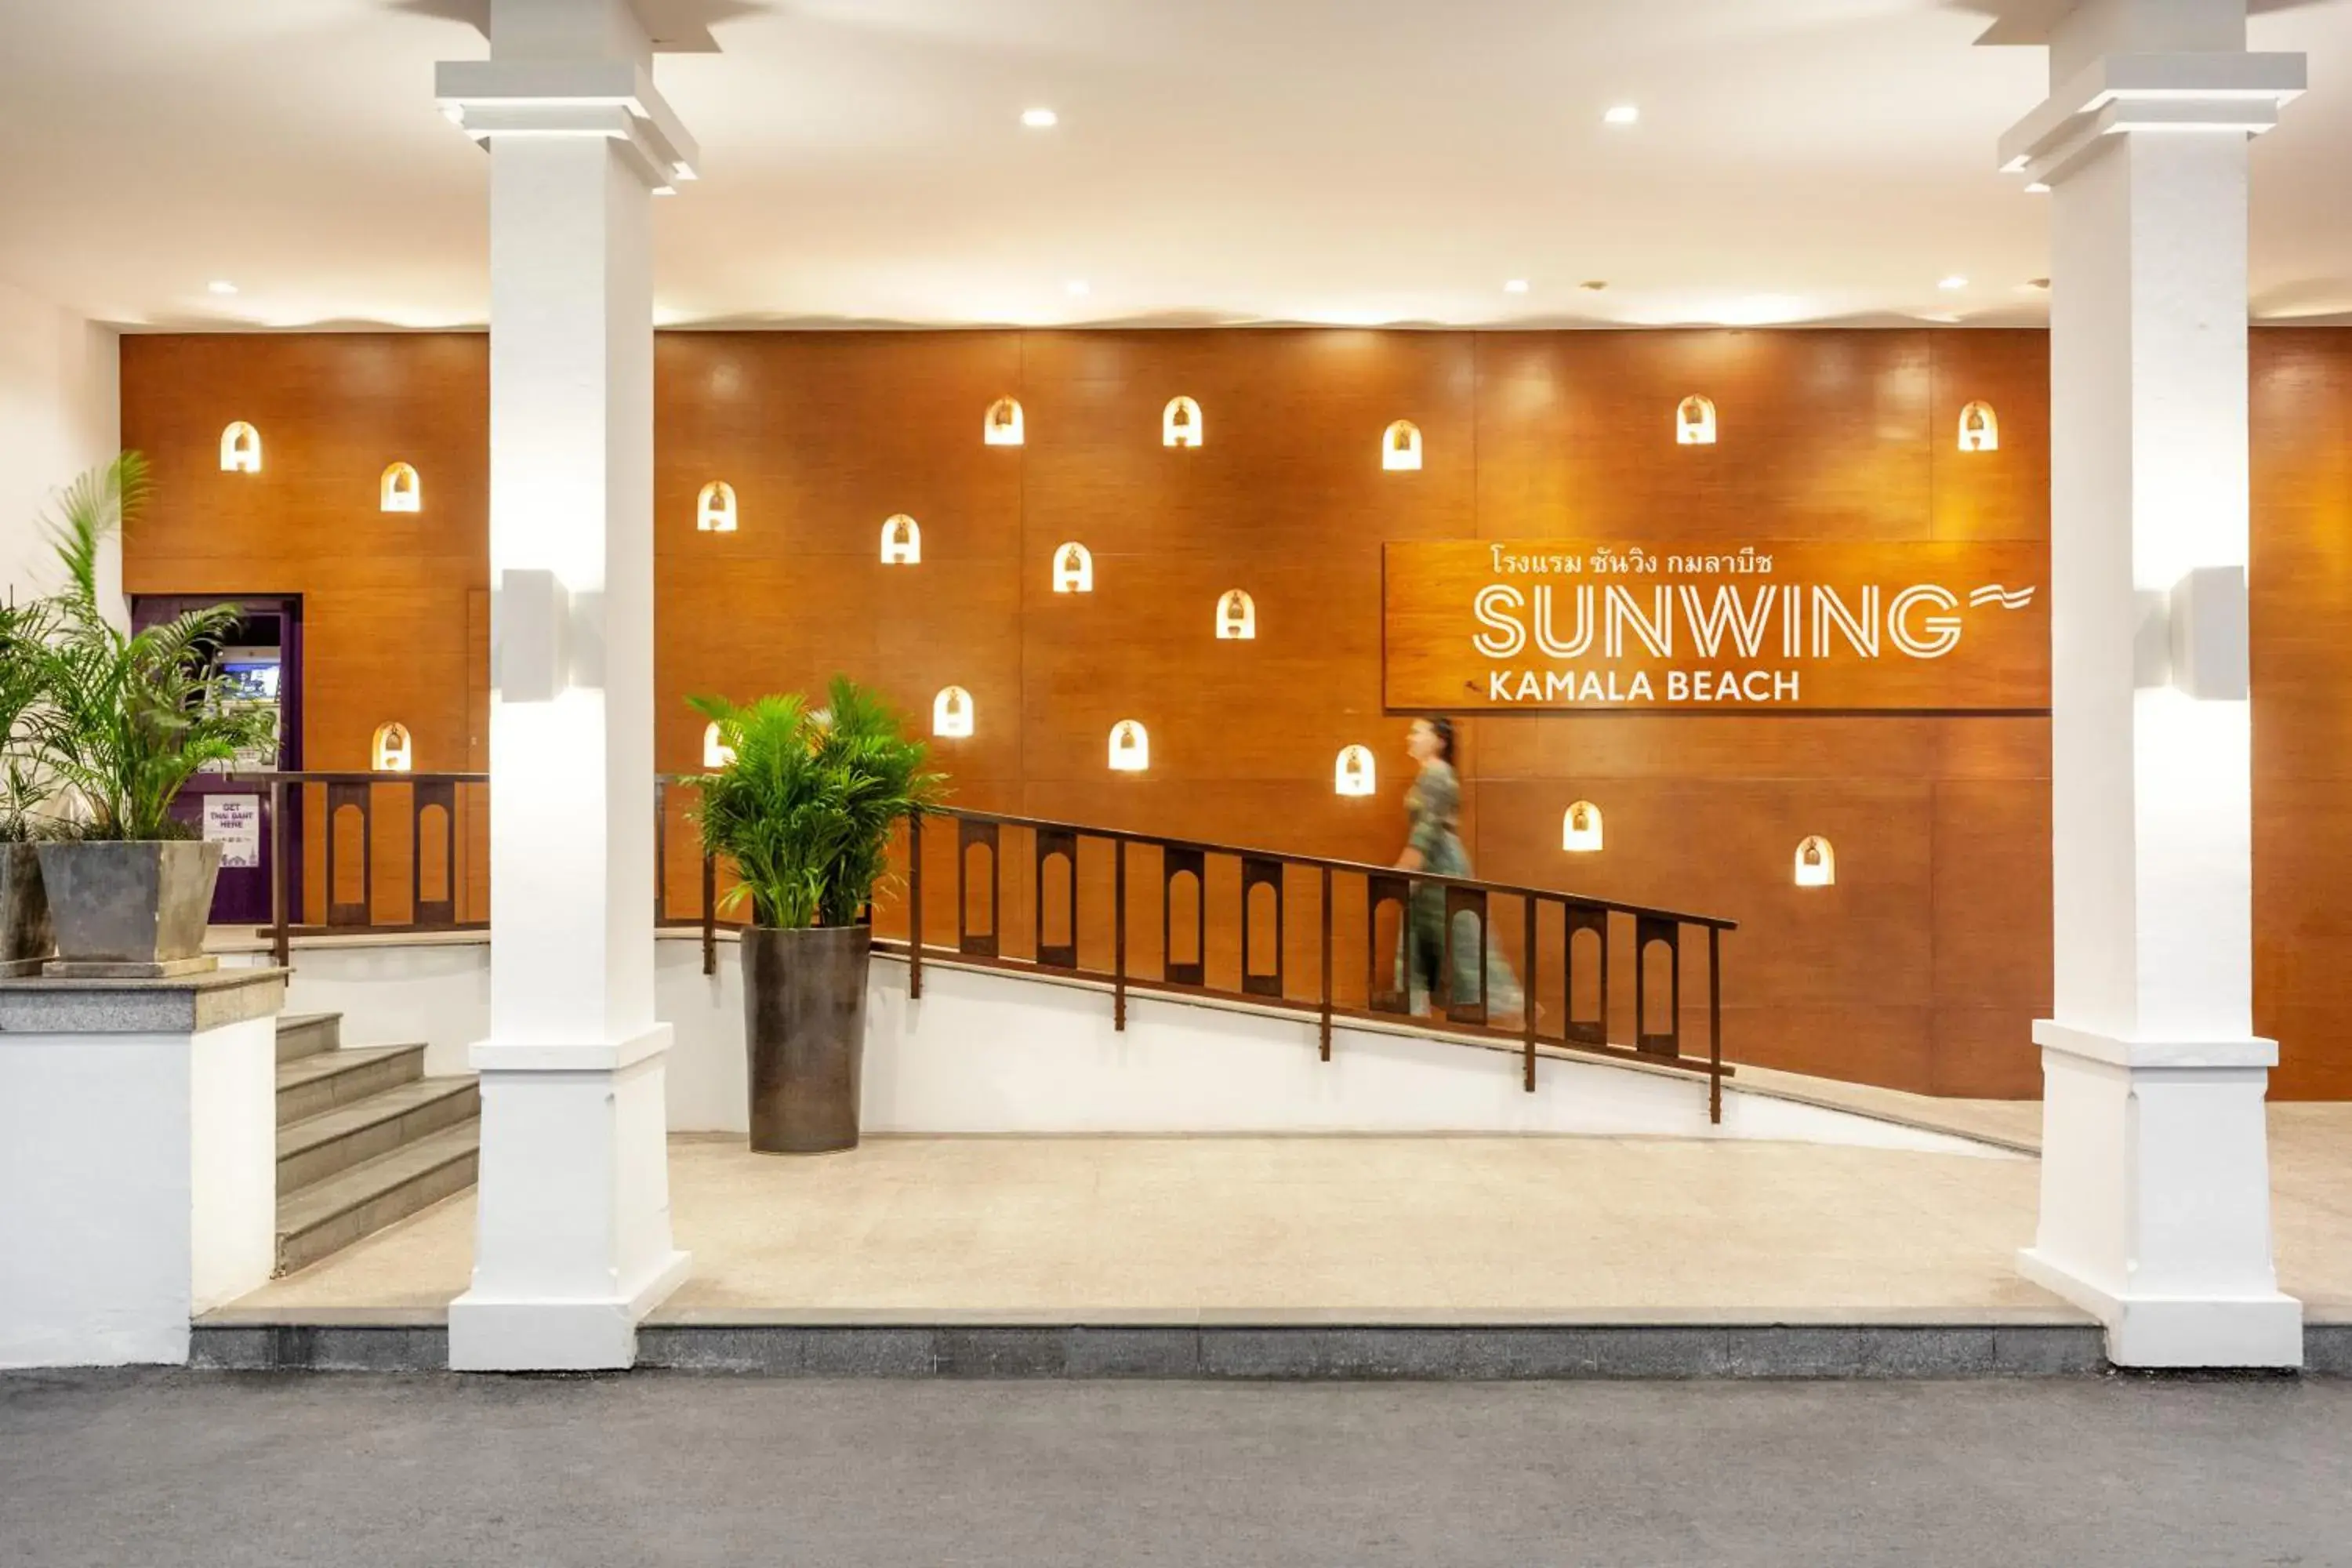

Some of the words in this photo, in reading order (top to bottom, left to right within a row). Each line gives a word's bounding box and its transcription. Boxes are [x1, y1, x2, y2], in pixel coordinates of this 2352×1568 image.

[1490, 544, 1581, 574] โรงแรม
[1473, 584, 1962, 659] SUNWING
[1489, 670, 1654, 702] KAMALA
[1667, 670, 1800, 702] BEACH
[223, 803, 240, 811] GET
